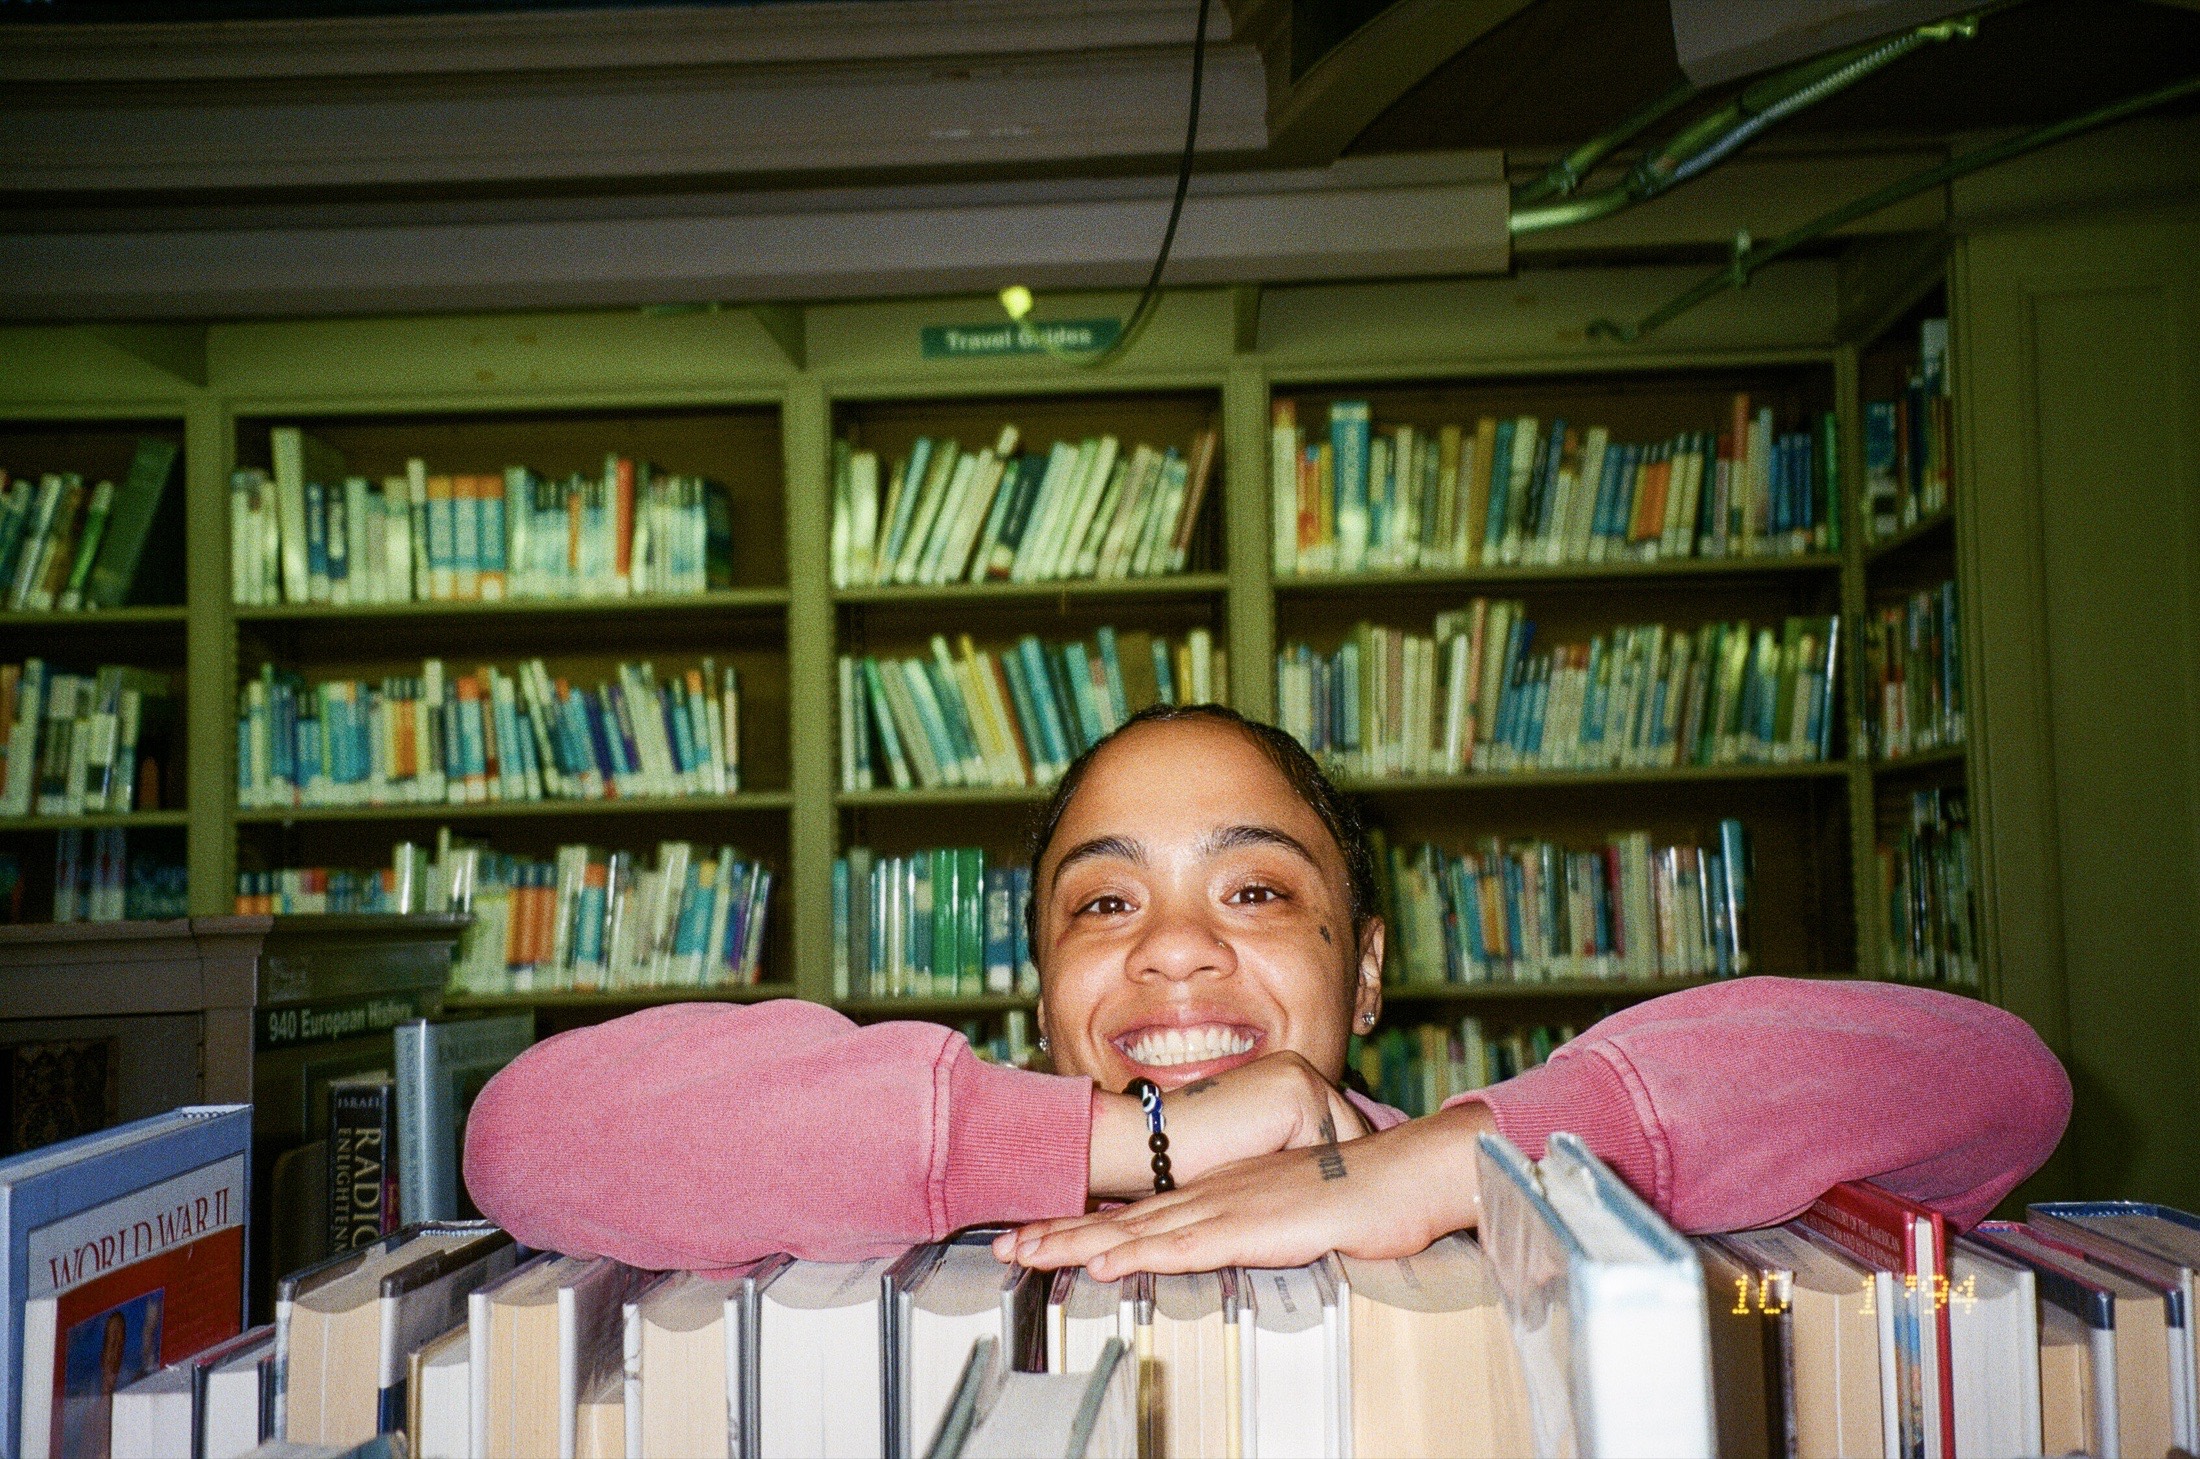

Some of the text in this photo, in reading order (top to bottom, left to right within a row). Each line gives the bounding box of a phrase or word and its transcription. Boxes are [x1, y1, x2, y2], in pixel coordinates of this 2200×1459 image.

[945, 330, 1011, 350] Travel
[268, 999, 413, 1042] 940 European History
[157, 1196, 208, 1248] WAR
[214, 1186, 230, 1226] II
